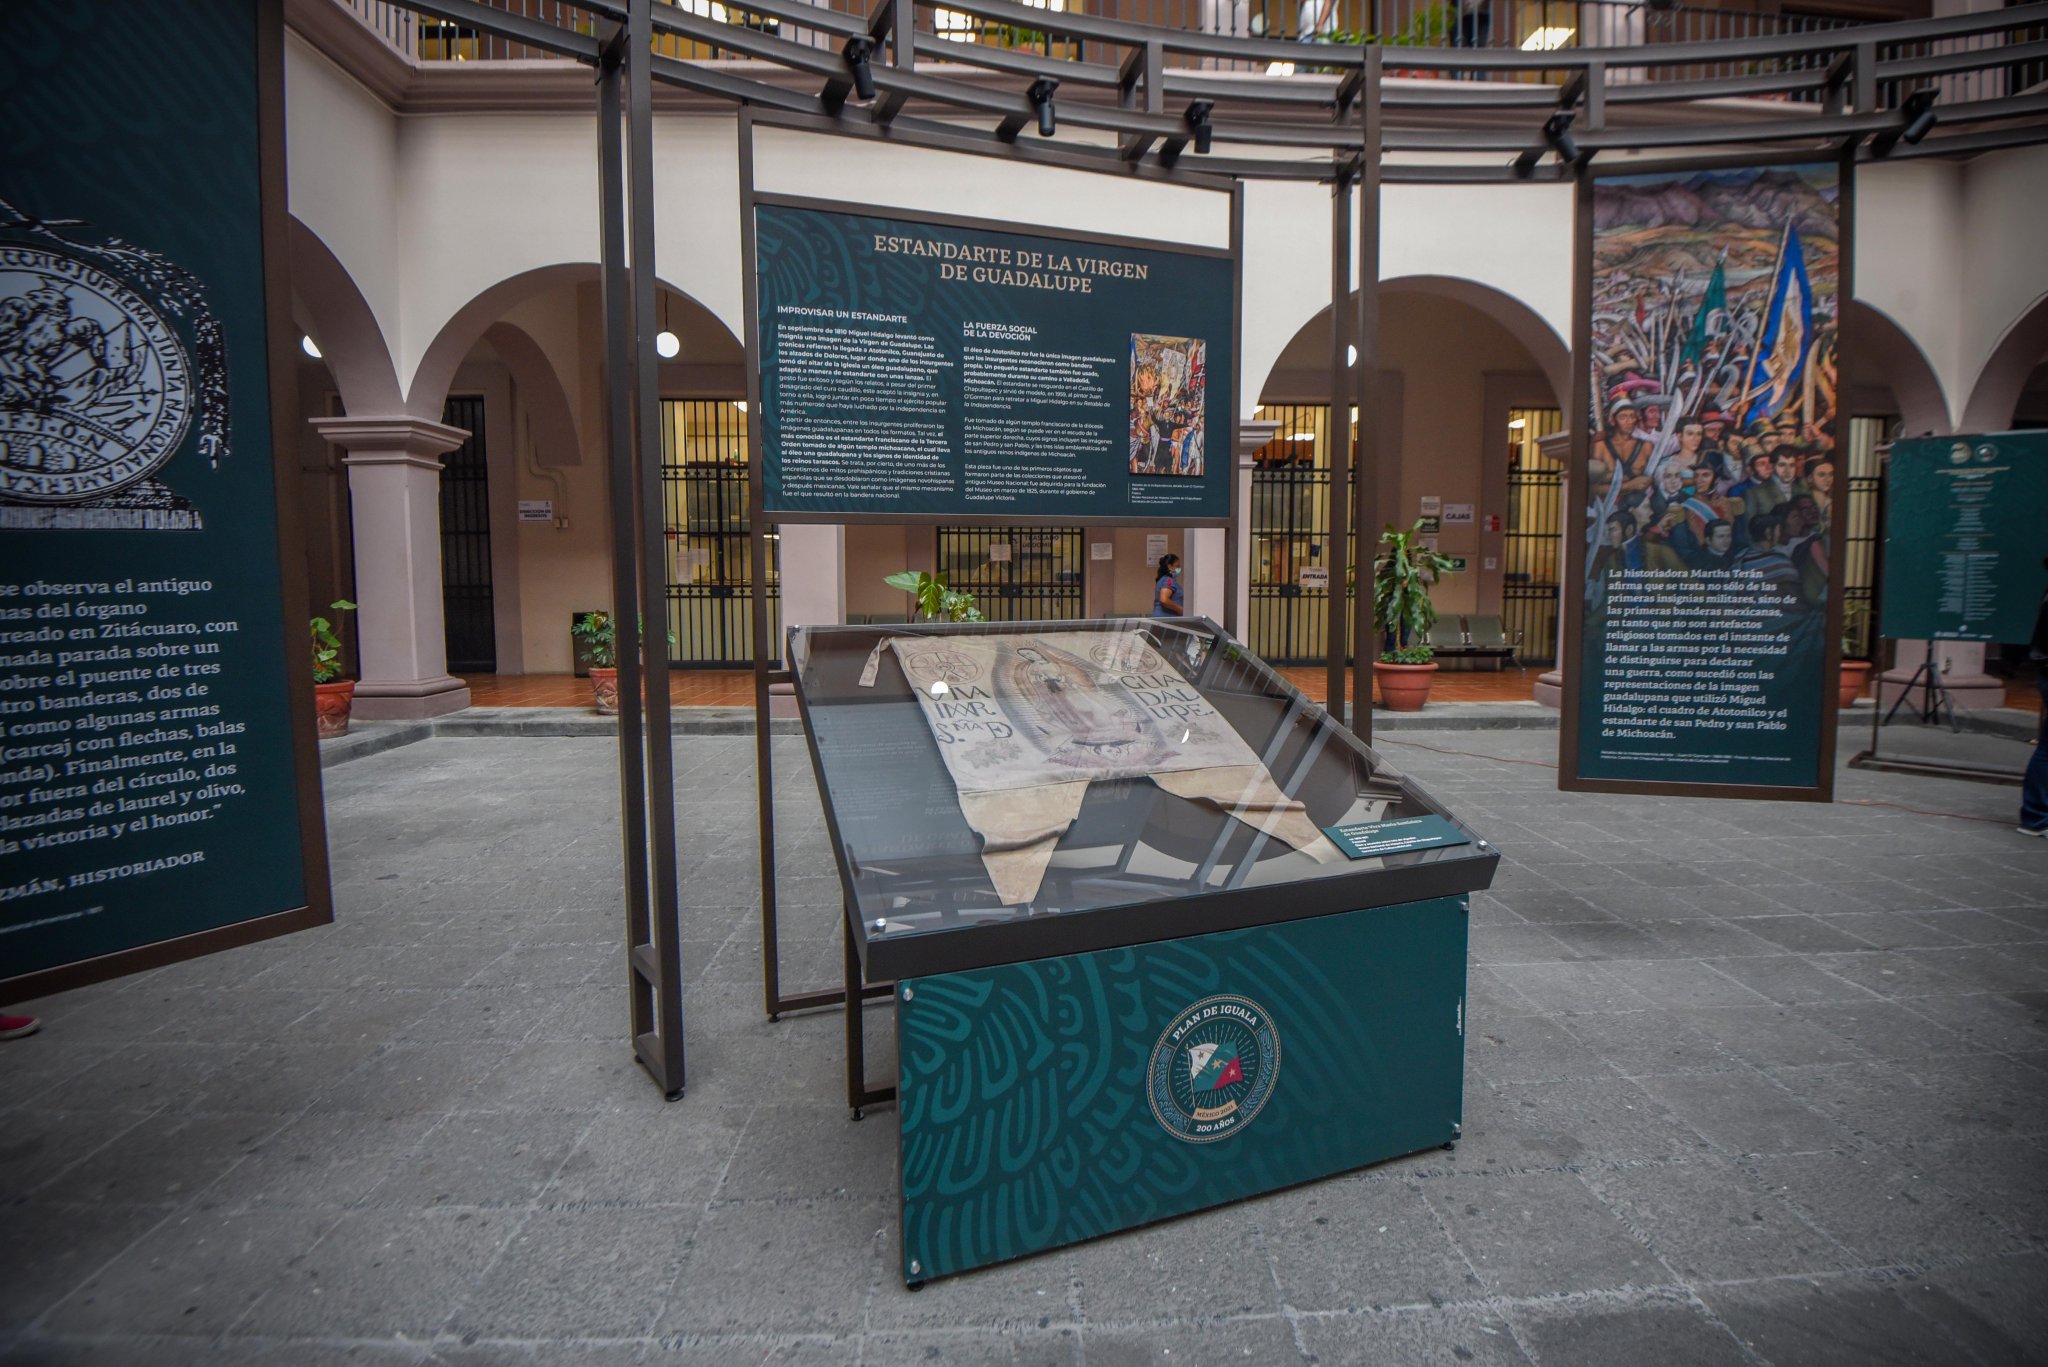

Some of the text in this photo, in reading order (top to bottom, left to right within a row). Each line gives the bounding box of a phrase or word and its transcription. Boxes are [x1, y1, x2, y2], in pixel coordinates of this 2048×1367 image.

[875, 235, 1147, 279] ESTANDARTE DE LA VIRGEN
[941, 264, 1091, 293] DE GUADALUPE
[778, 306, 833, 317] IMPROVISAR
[852, 312, 907, 323] ESTANDARTE
[976, 322, 1007, 331] FUERZA
[989, 331, 1030, 341] DEVOCIÓN
[1609, 569, 1763, 578] La historiadora Martha Terán
[26, 581, 109, 595] observa
[115, 579, 132, 593] el
[138, 578, 212, 595] antiguo
[1608, 594, 1796, 605] primeras insignias militares, sino de
[37, 603, 70, 618] del
[76, 602, 147, 620] órgano
[1607, 606, 1783, 617] las primeras banderas mexicanas,
[70, 628, 94, 639] en
[101, 622, 200, 638] Zitácuaro,
[205, 622, 238, 632] con
[0, 643, 220, 667] nada parada sobre un
[1605, 655, 1753, 667] de distinguirse para declarar
[57, 671, 74, 685] el
[81, 668, 151, 688] puente
[157, 664, 179, 678] de
[184, 664, 221, 676] tres
[1121, 674, 1186, 689] GUA
[1627, 670, 1662, 678] guerra,
[1696, 670, 1735, 678] sucedió
[1759, 671, 1774, 679] las
[1604, 681, 1759, 693] representaciones de la imagen
[41, 691, 142, 710] banderas,
[148, 686, 181, 700] dos
[186, 683, 208, 696] de
[1132, 689, 1200, 706] DAL
[1603, 692, 1765, 706] guadalupana que utilizó Miguel
[12, 720, 71, 736] como
[77, 711, 155, 731] algunas
[161, 705, 220, 720] armas
[1602, 728, 1676, 738] de Michoacán.
[0, 721, 245, 763] (carcaj con flechas, balas
[68, 750, 188, 775] Finalmente,
[193, 747, 215, 758] en
[220, 742, 237, 755] la
[31, 785, 86, 803] fuera
[93, 776, 124, 794] del
[129, 768, 200, 788] círculo,
[205, 764, 237, 778] dos
[90, 801, 113, 816] de
[120, 790, 176, 812] laurel
[180, 791, 192, 806] y
[197, 784, 245, 799] olivo,
[24, 824, 108, 849] victoria
[112, 823, 125, 839] y
[130, 816, 147, 831] el
[71, 851, 205, 887] HISTORIADOR
[1173, 1006, 1257, 1040] PLAN DE IGUALA
[1196, 1117, 1234, 1132] 200 AÑOS
